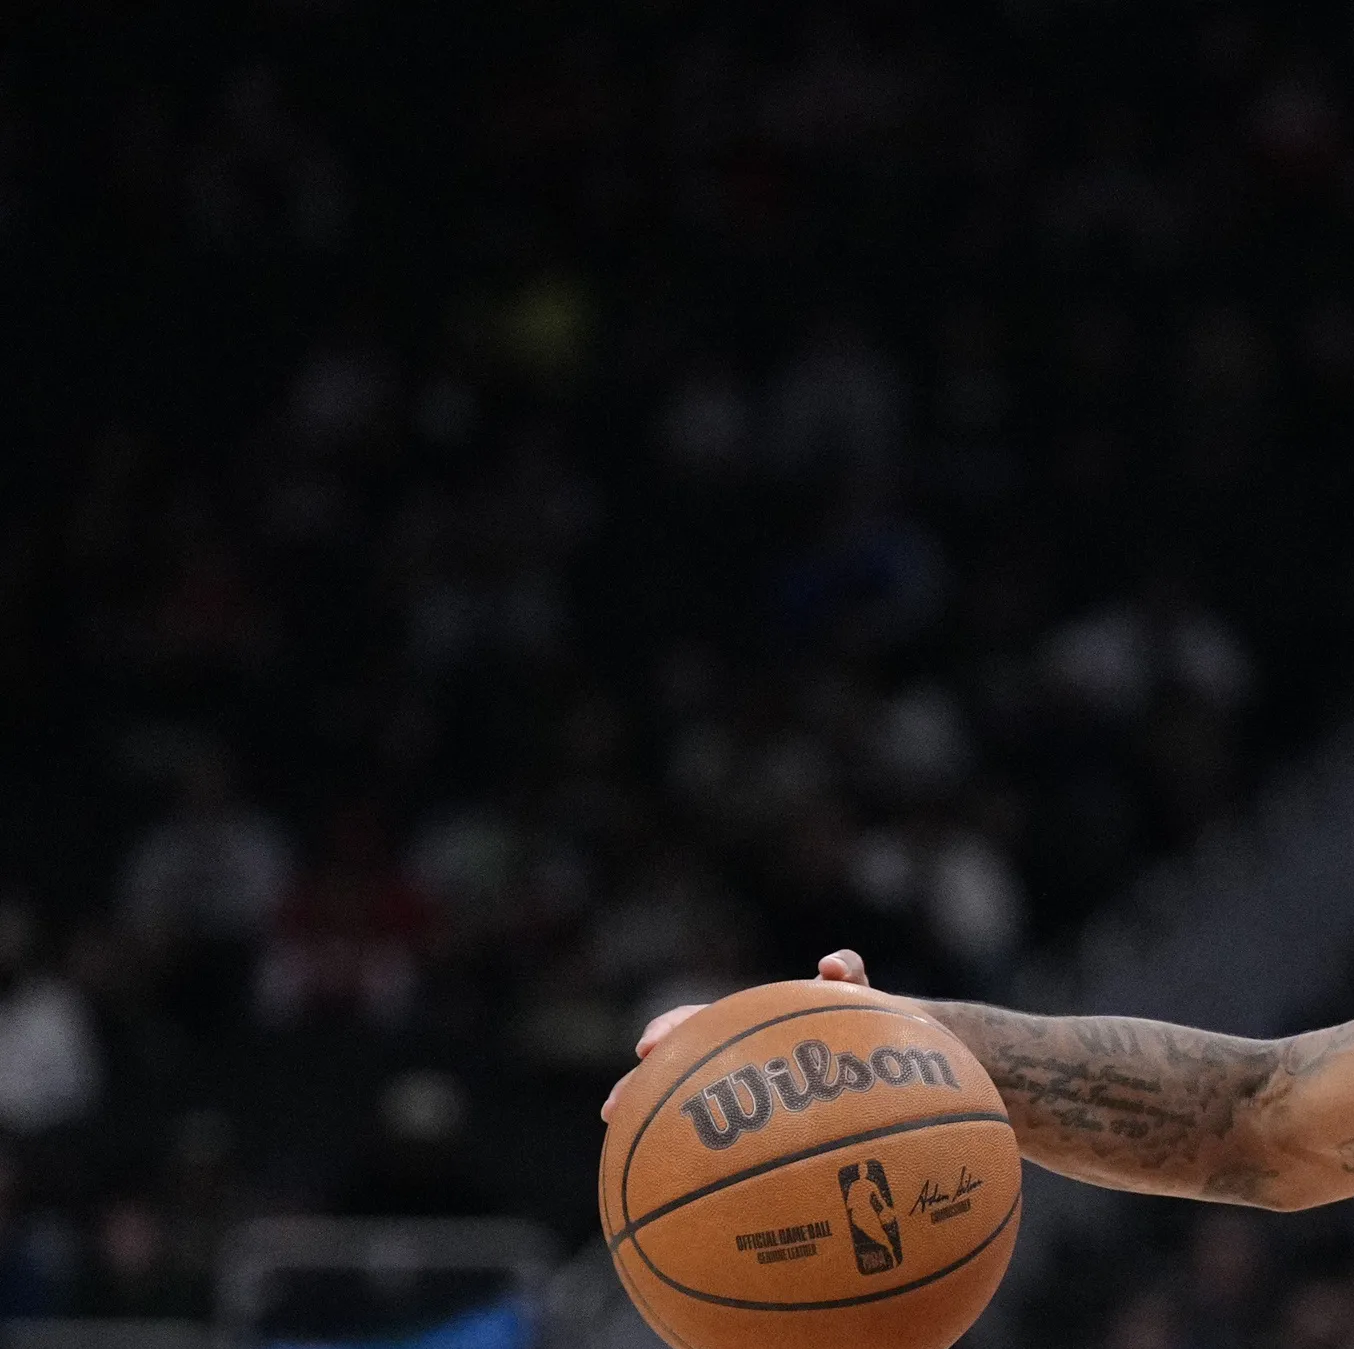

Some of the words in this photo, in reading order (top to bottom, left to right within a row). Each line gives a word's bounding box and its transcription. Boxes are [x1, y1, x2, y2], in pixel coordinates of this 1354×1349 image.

[681, 1039, 961, 1150] Wilson
[736, 1229, 778, 1251] OFFICIAL
[807, 1220, 832, 1239] BALL
